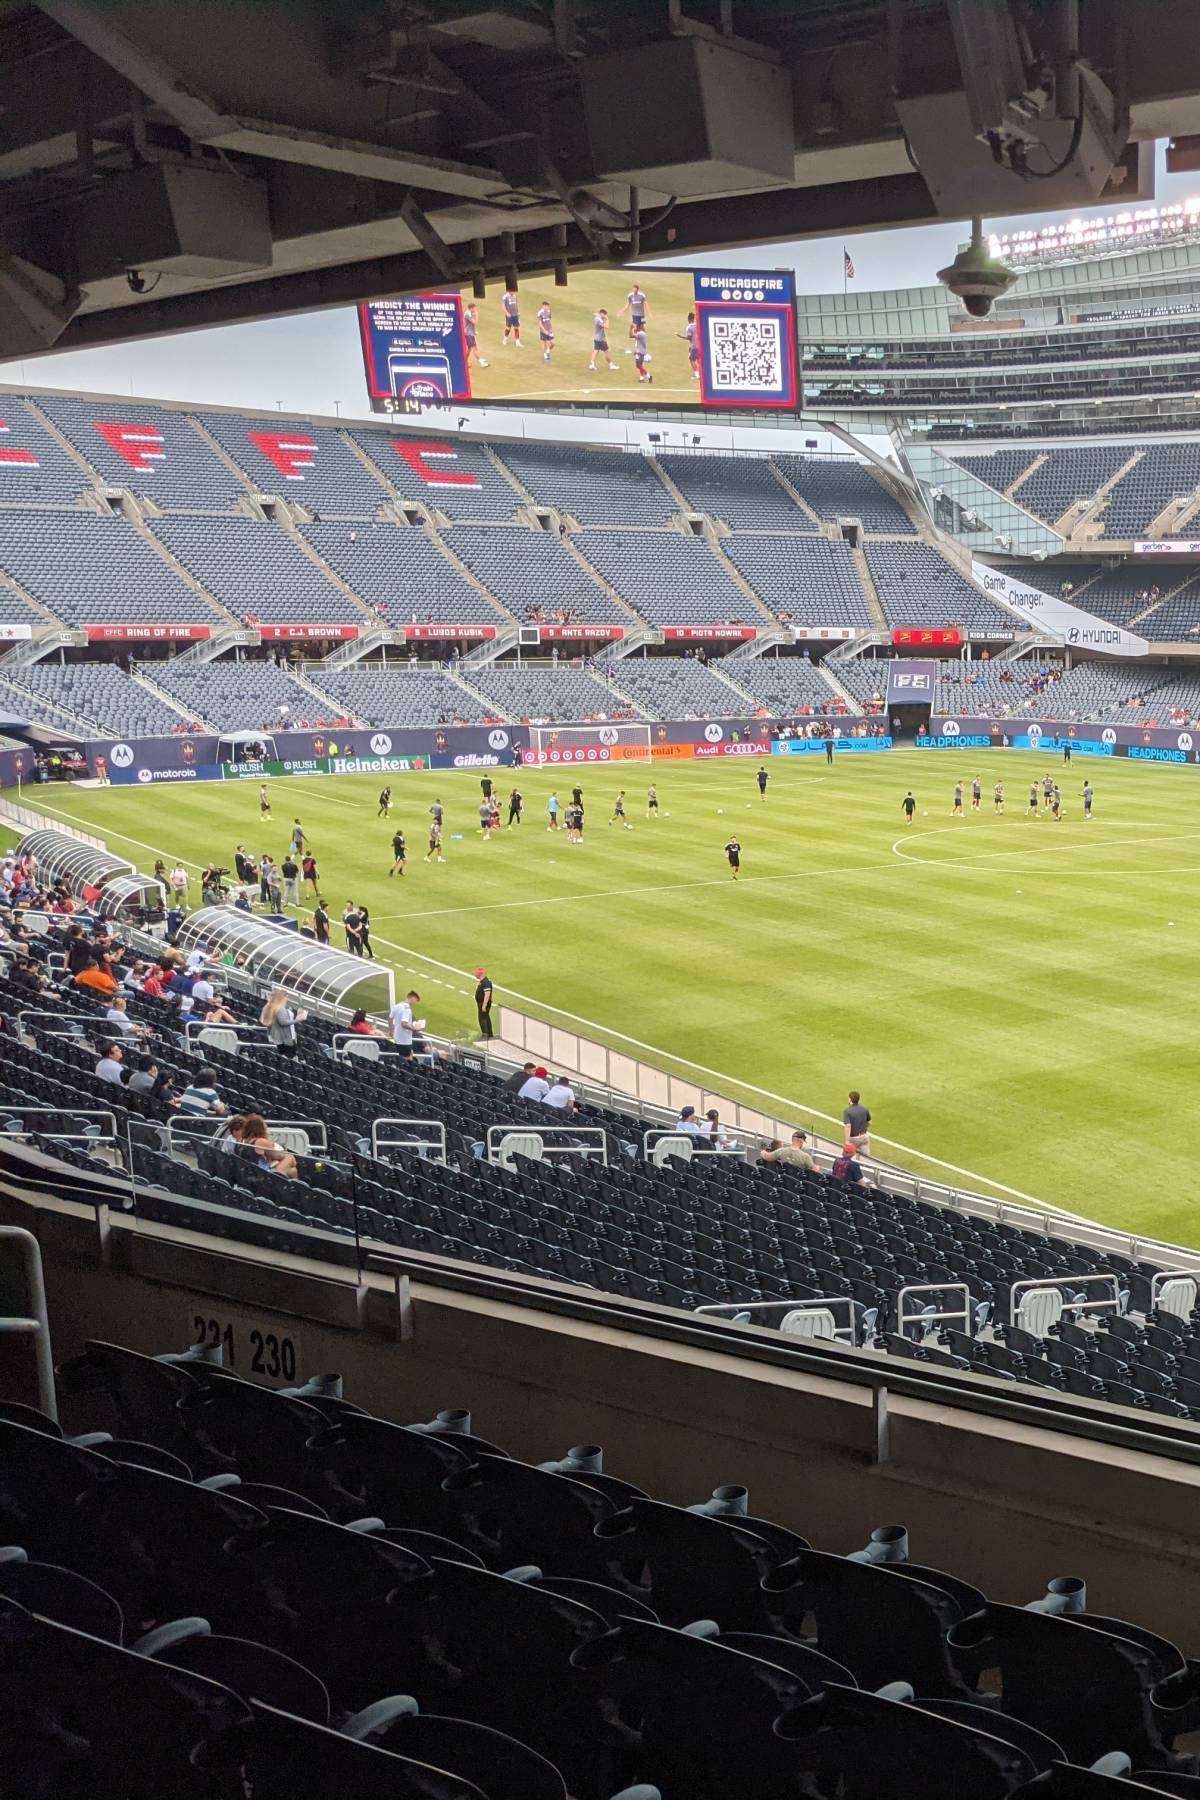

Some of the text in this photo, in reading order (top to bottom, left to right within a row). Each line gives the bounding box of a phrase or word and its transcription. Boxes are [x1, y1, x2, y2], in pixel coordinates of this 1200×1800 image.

[701, 277, 783, 289] @CHICAGOFIRE
[405, 302, 420, 310] THE
[423, 303, 455, 311] WINNER
[1143, 542, 1165, 550] gerber
[984, 574, 1006, 590] Game
[1009, 591, 1044, 610] Changer.
[127, 628, 150, 636] RING
[169, 628, 191, 636] FIRE
[289, 628, 306, 636] C.J.
[308, 628, 341, 636] BROWN
[562, 629, 582, 637] ANTE
[585, 629, 611, 637] RAZOV
[676, 629, 685, 637] 10
[969, 631, 1013, 639] KIDS CORNER
[1082, 629, 1121, 644] HYUNDAI
[916, 735, 991, 748] HEADPHONES
[697, 743, 718, 754] Audi
[454, 753, 499, 767] Gillette
[1127, 746, 1187, 763] HEADPHONES
[239, 763, 264, 772] RUSH
[293, 760, 317, 769] RUSH
[335, 758, 410, 773] Heineken
[153, 768, 196, 779] motorola
[250, 1330, 295, 1382] 230
